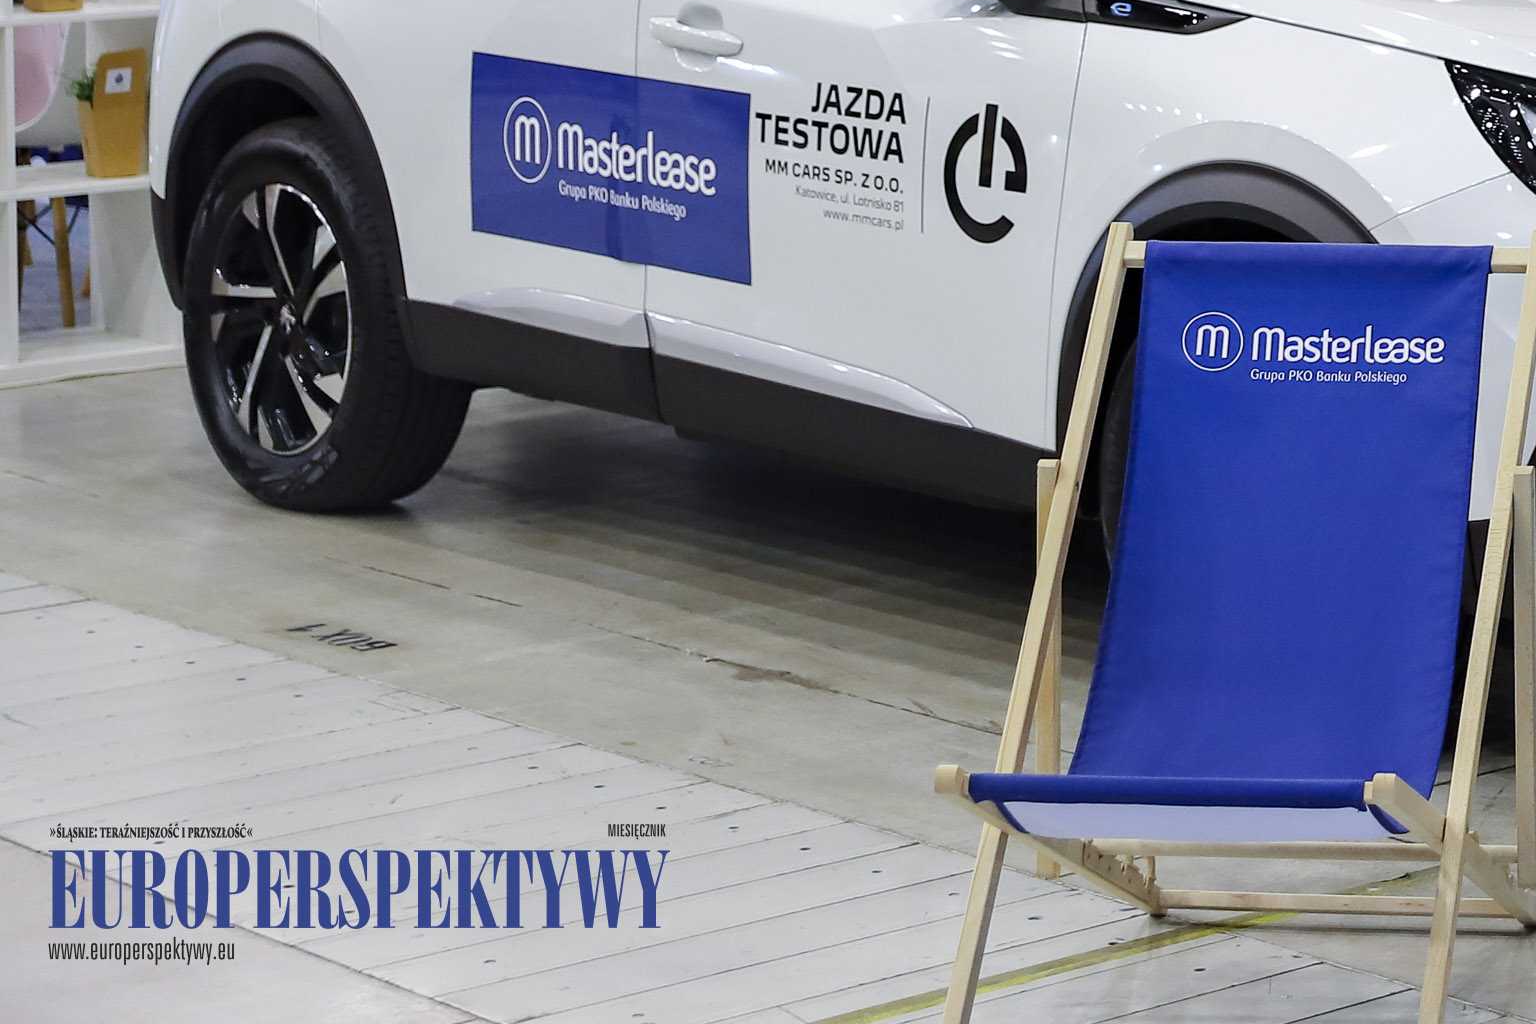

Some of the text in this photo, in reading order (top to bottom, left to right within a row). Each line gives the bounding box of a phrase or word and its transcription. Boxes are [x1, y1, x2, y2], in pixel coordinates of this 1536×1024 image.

[811, 82, 906, 125] JAZDA
[755, 112, 904, 164] TESTOWA
[557, 121, 717, 197] Masterlease
[765, 159, 904, 194] MM CARS SP. Z O.O.
[558, 179, 687, 221] Grupa PKO Banku Polskiego
[796, 185, 838, 204] Katowice,
[853, 194, 892, 211] Lotnisko
[893, 201, 904, 213] 81
[823, 208, 904, 231] www.mmcars.pl
[1251, 325, 1445, 364] Masterlease
[1250, 368, 1408, 385] Grupa PKO Banku Polskiego
